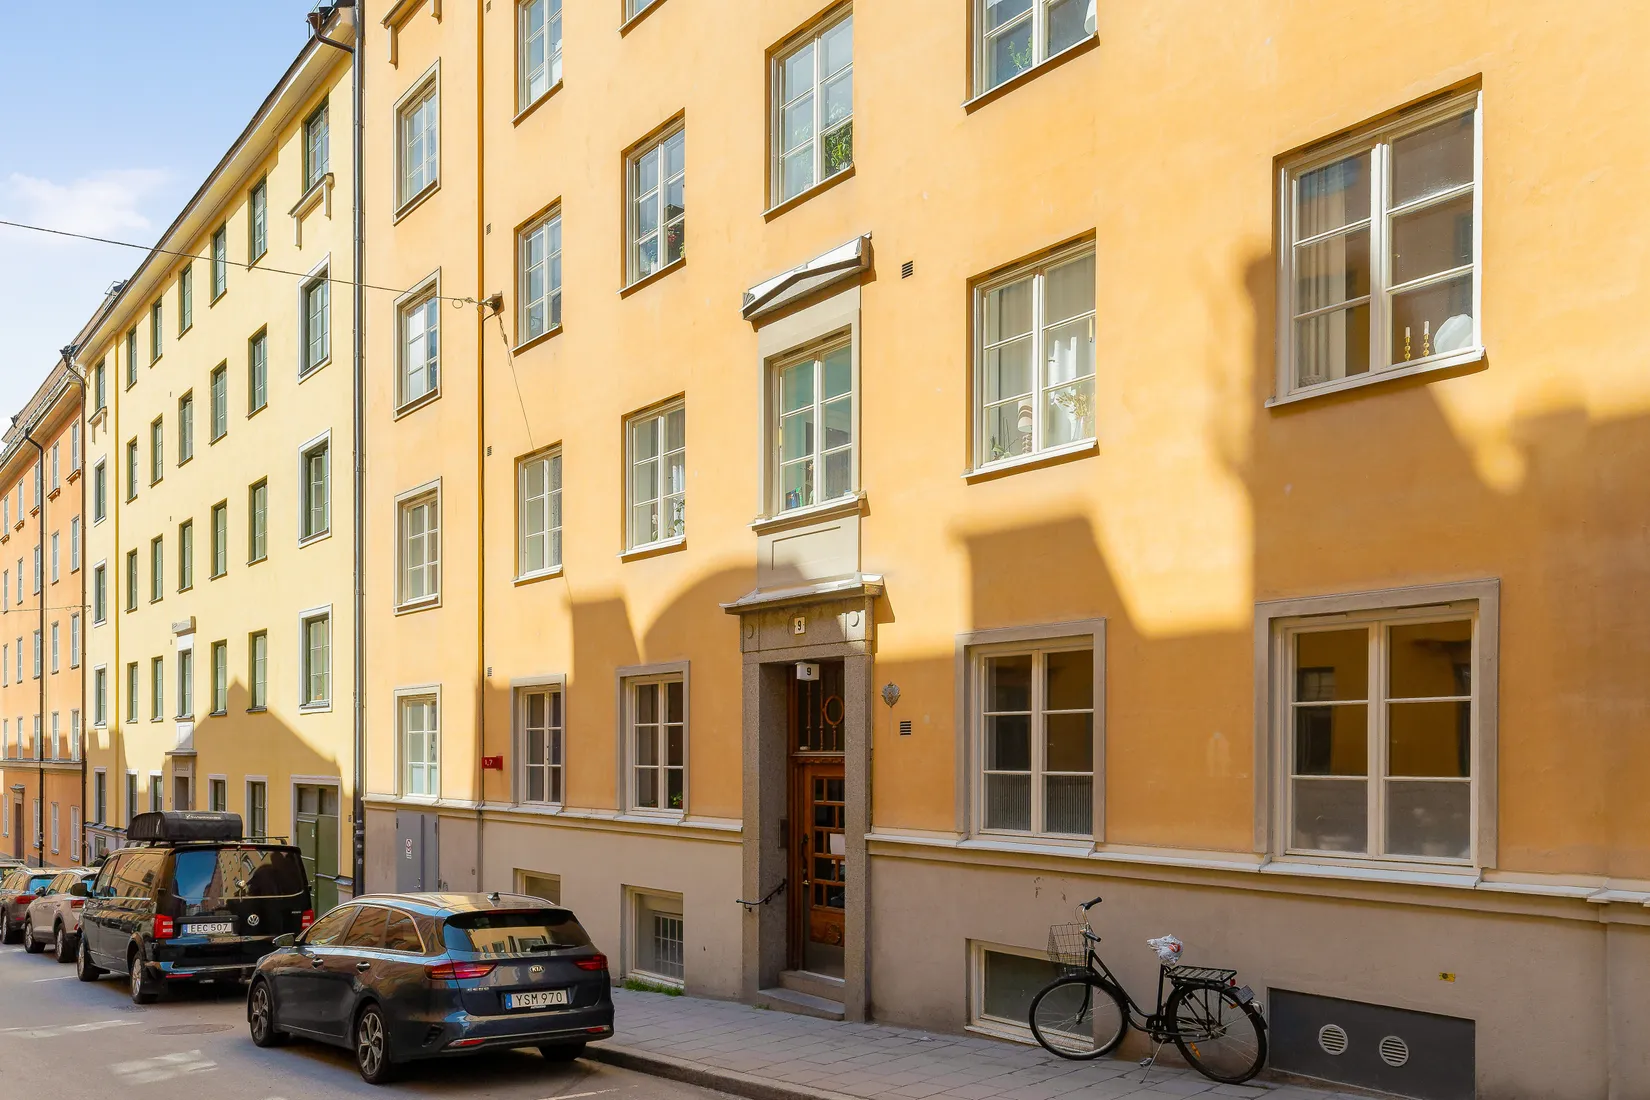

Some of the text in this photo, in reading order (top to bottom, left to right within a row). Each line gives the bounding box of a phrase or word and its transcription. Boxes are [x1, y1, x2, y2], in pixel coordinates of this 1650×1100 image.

[797, 620, 802, 630] 9
[806, 667, 811, 676] 9
[190, 923, 228, 932] EEC 507
[516, 992, 563, 1006] YSM 970
